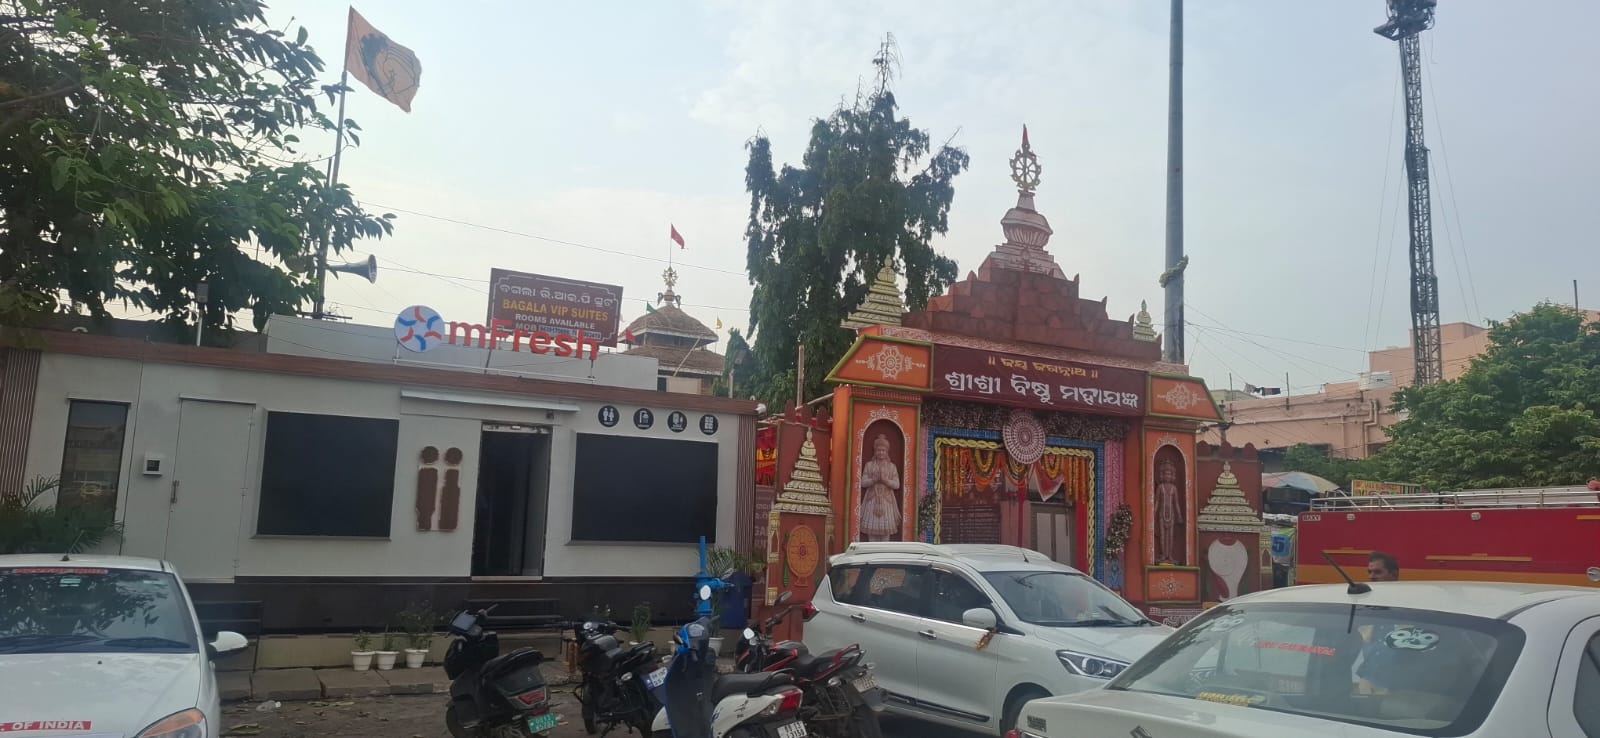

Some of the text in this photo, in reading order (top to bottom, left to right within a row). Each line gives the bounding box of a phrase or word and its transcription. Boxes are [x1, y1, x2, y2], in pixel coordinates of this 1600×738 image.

[503, 299, 609, 321] BAGALA VIP SUITES
[515, 313, 596, 330] ROOMS AVAILABLE
[449, 318, 599, 361] mFresh
[12, 722, 33, 730] OF
[39, 720, 84, 730] INDIA
